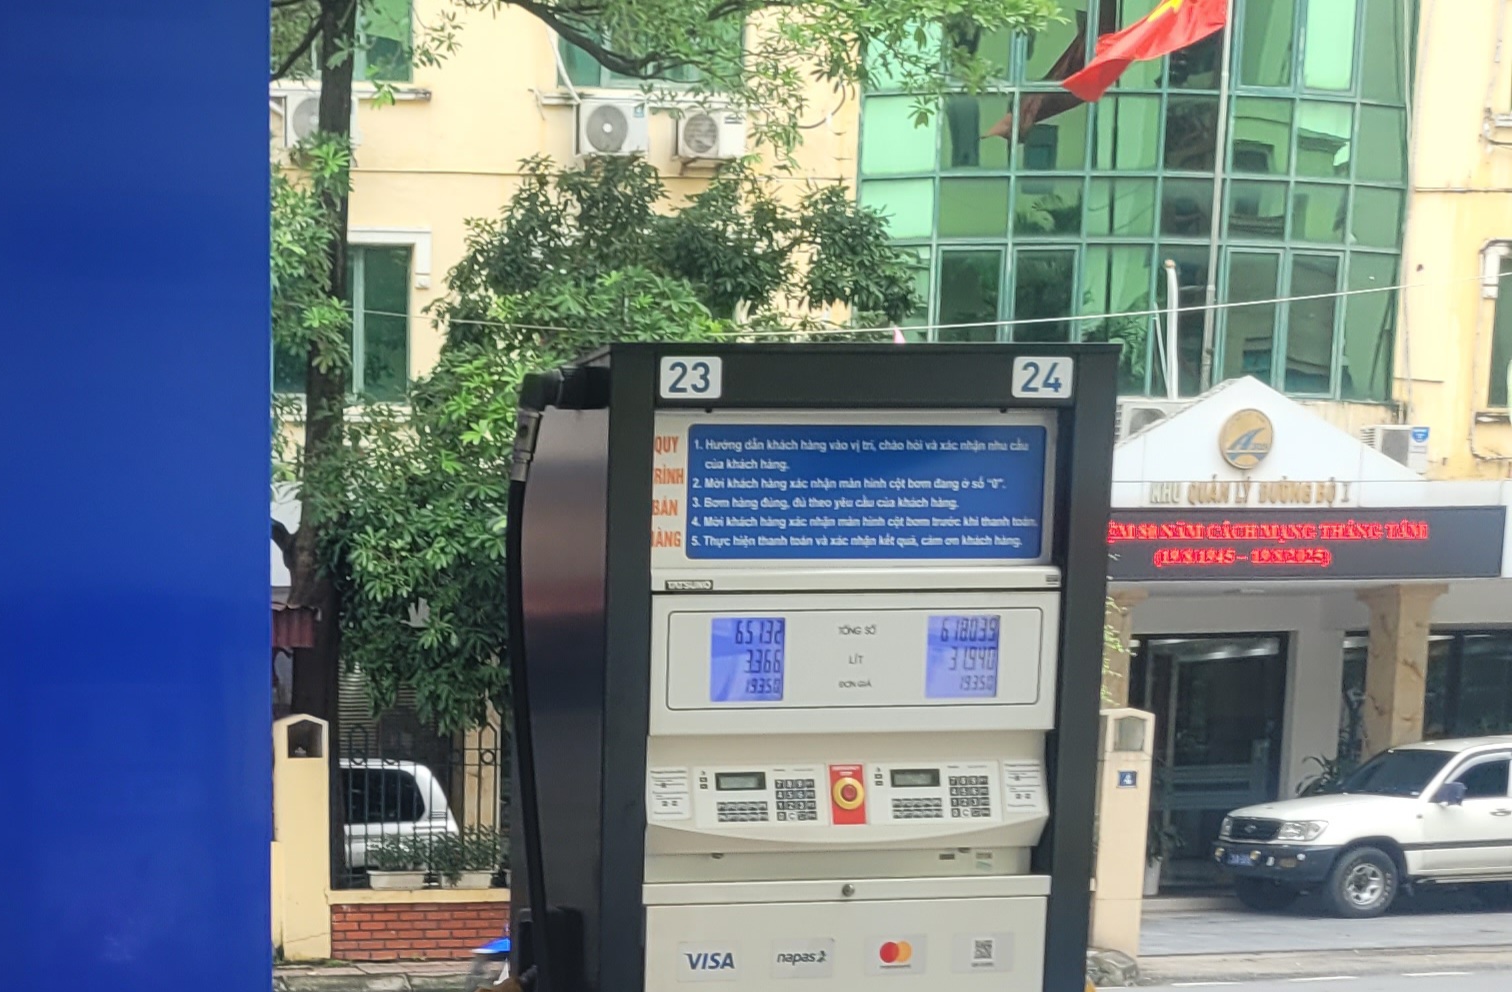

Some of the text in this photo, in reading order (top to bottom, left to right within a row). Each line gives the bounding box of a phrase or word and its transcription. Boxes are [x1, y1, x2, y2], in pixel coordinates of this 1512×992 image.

[668, 361, 711, 393] 23
[1021, 361, 1062, 393] 24
[654, 436, 679, 453] QUY
[653, 464, 684, 485] RÌNH
[684, 953, 735, 970] VISA
